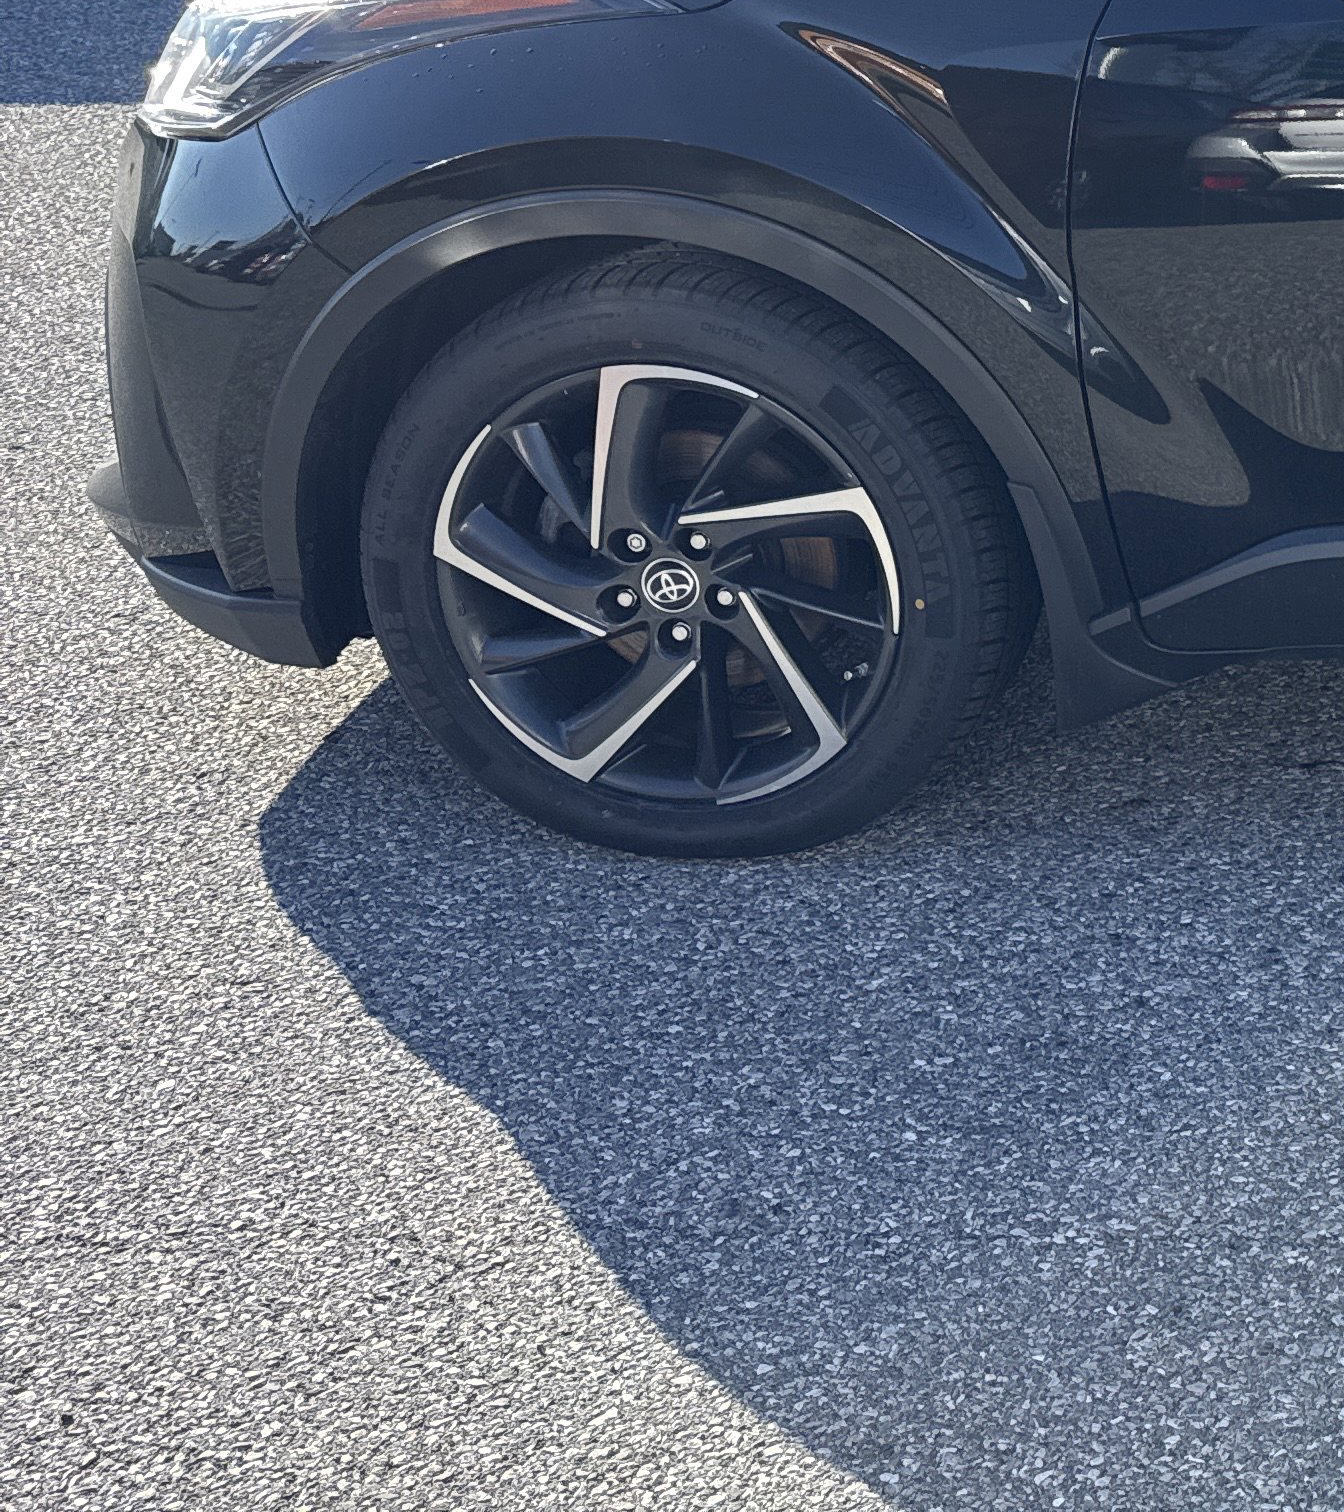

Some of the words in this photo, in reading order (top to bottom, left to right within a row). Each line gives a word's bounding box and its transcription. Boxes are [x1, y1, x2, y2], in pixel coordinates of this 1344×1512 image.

[698, 320, 768, 351] OUTSIDE
[380, 422, 422, 500] SEASON
[373, 507, 389, 544] ALL
[845, 413, 949, 605] ADVANTA
